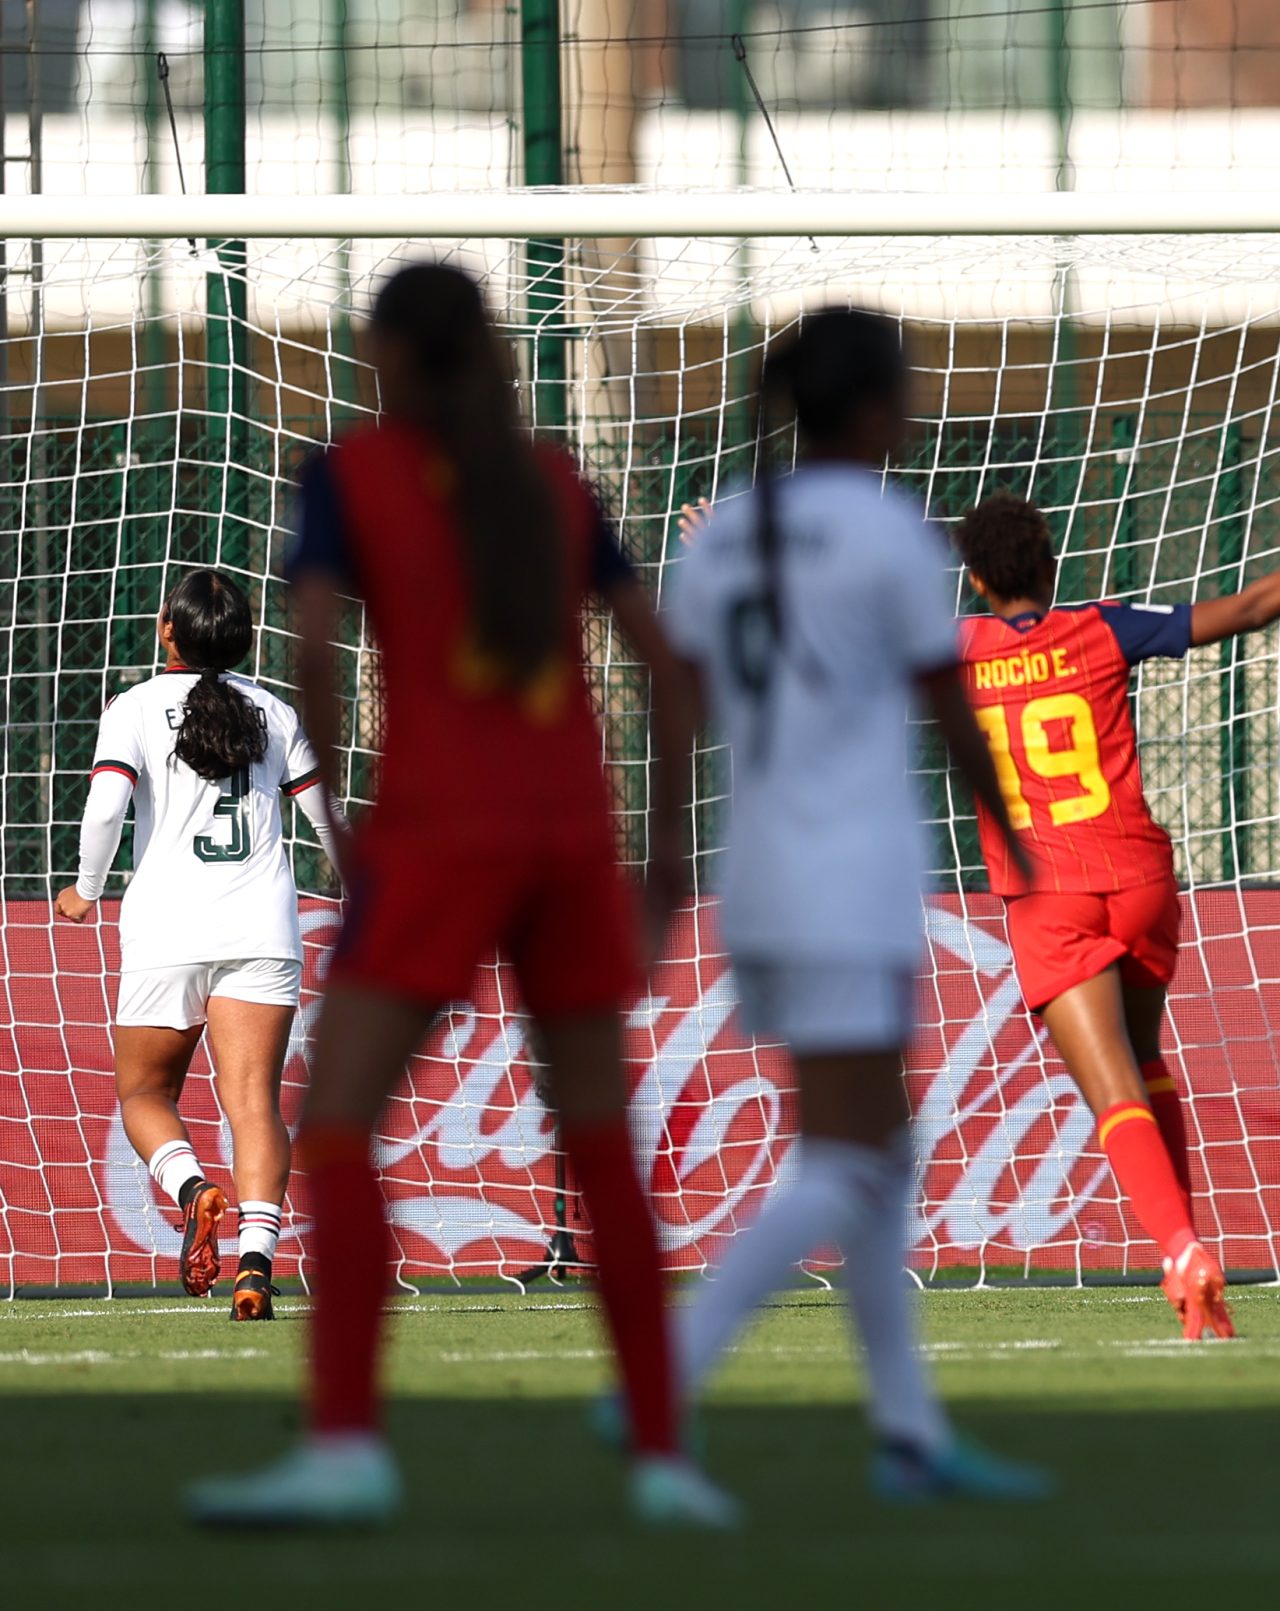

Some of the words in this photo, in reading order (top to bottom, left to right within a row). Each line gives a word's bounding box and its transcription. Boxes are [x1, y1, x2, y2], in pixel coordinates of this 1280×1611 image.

[975, 649, 1049, 690] ROCÍO
[1052, 648, 1078, 678] E.
[975, 693, 1111, 831] 19
